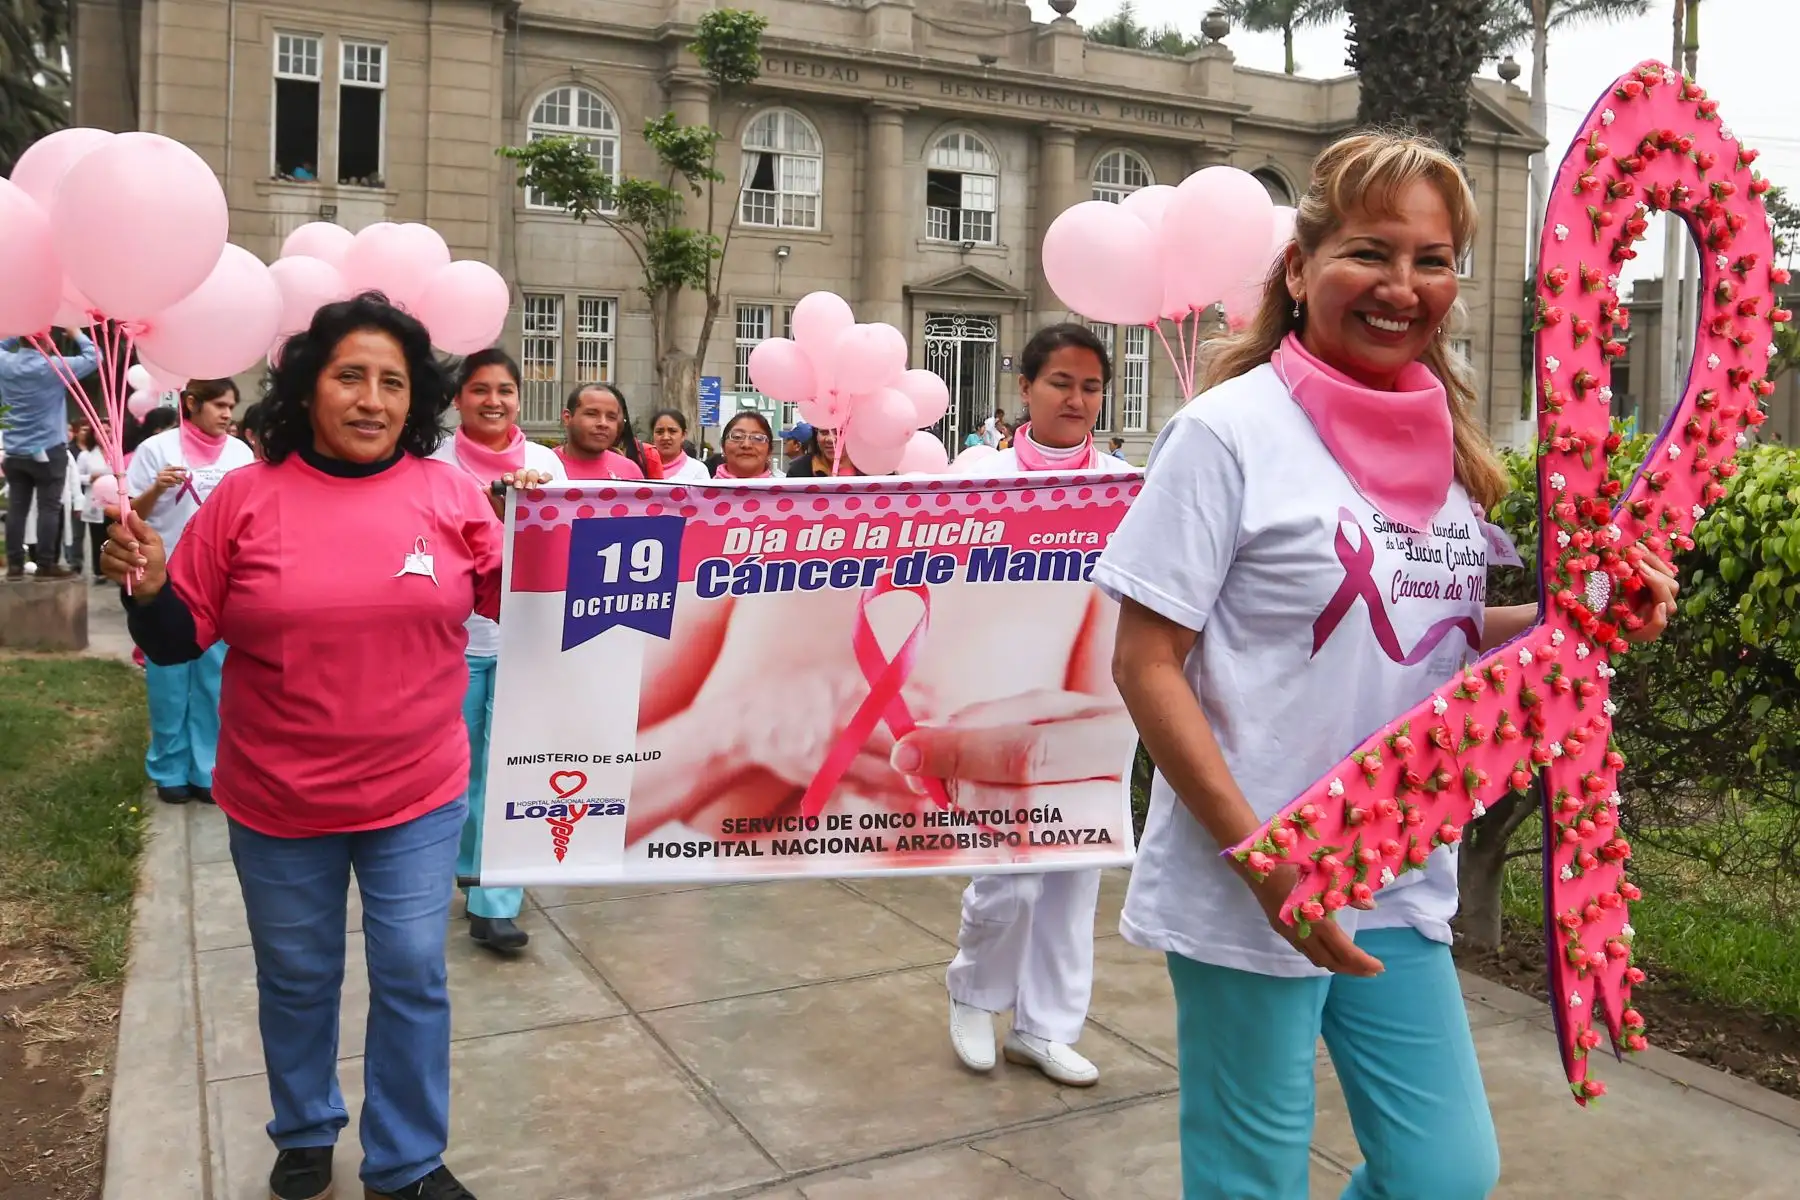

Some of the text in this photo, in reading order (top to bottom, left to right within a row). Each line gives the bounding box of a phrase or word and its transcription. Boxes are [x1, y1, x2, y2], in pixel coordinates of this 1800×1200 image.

[761, 57, 859, 84] CIEDAD
[885, 73, 915, 90] DE
[940, 80, 1101, 116] BENEFICENCIA
[722, 517, 1099, 555] Día de la Lucha contra
[1386, 536, 1395, 549] de
[1396, 537, 1405, 550] la
[1446, 542, 1485, 571] Contra
[596, 538, 664, 584] 19
[695, 554, 887, 600] Cáncer
[892, 550, 955, 587] de
[1391, 569, 1440, 604] Cáncer
[1443, 574, 1463, 601] de
[572, 591, 672, 618] OCTUBRE
[507, 750, 662, 766] MINISTERIO DE SALUD
[505, 802, 626, 823] Loayza
[722, 803, 1063, 834] SERVICIO DE ONCO HEMATOLOGÍA
[647, 828, 1113, 859] HOSPITAL NACIONAL ARZOBISPO LOAYZA
